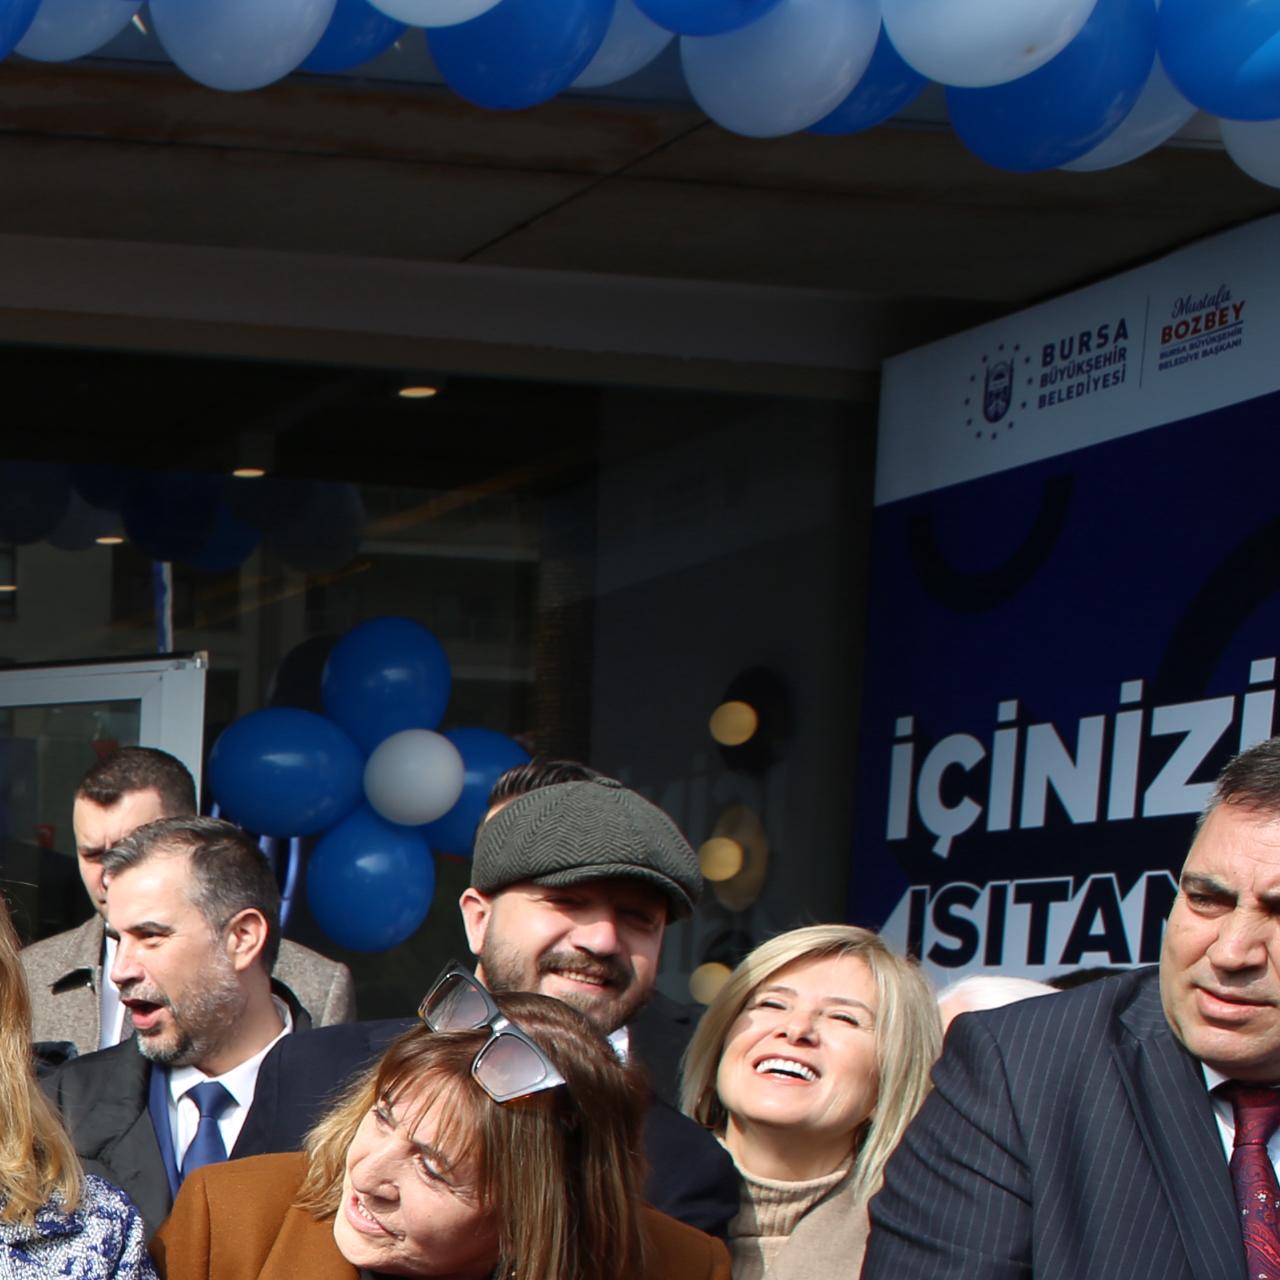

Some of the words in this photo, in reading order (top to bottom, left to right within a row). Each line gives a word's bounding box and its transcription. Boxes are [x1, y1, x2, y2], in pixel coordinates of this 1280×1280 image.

[1160, 300, 1246, 345] BOZBEY
[1171, 283, 1231, 319] Mustafa
[1042, 318, 1128, 368] BURSA
[1038, 363, 1126, 409] BELEDİYESİ
[1040, 345, 1127, 388] BÜYÜKŞEHİR
